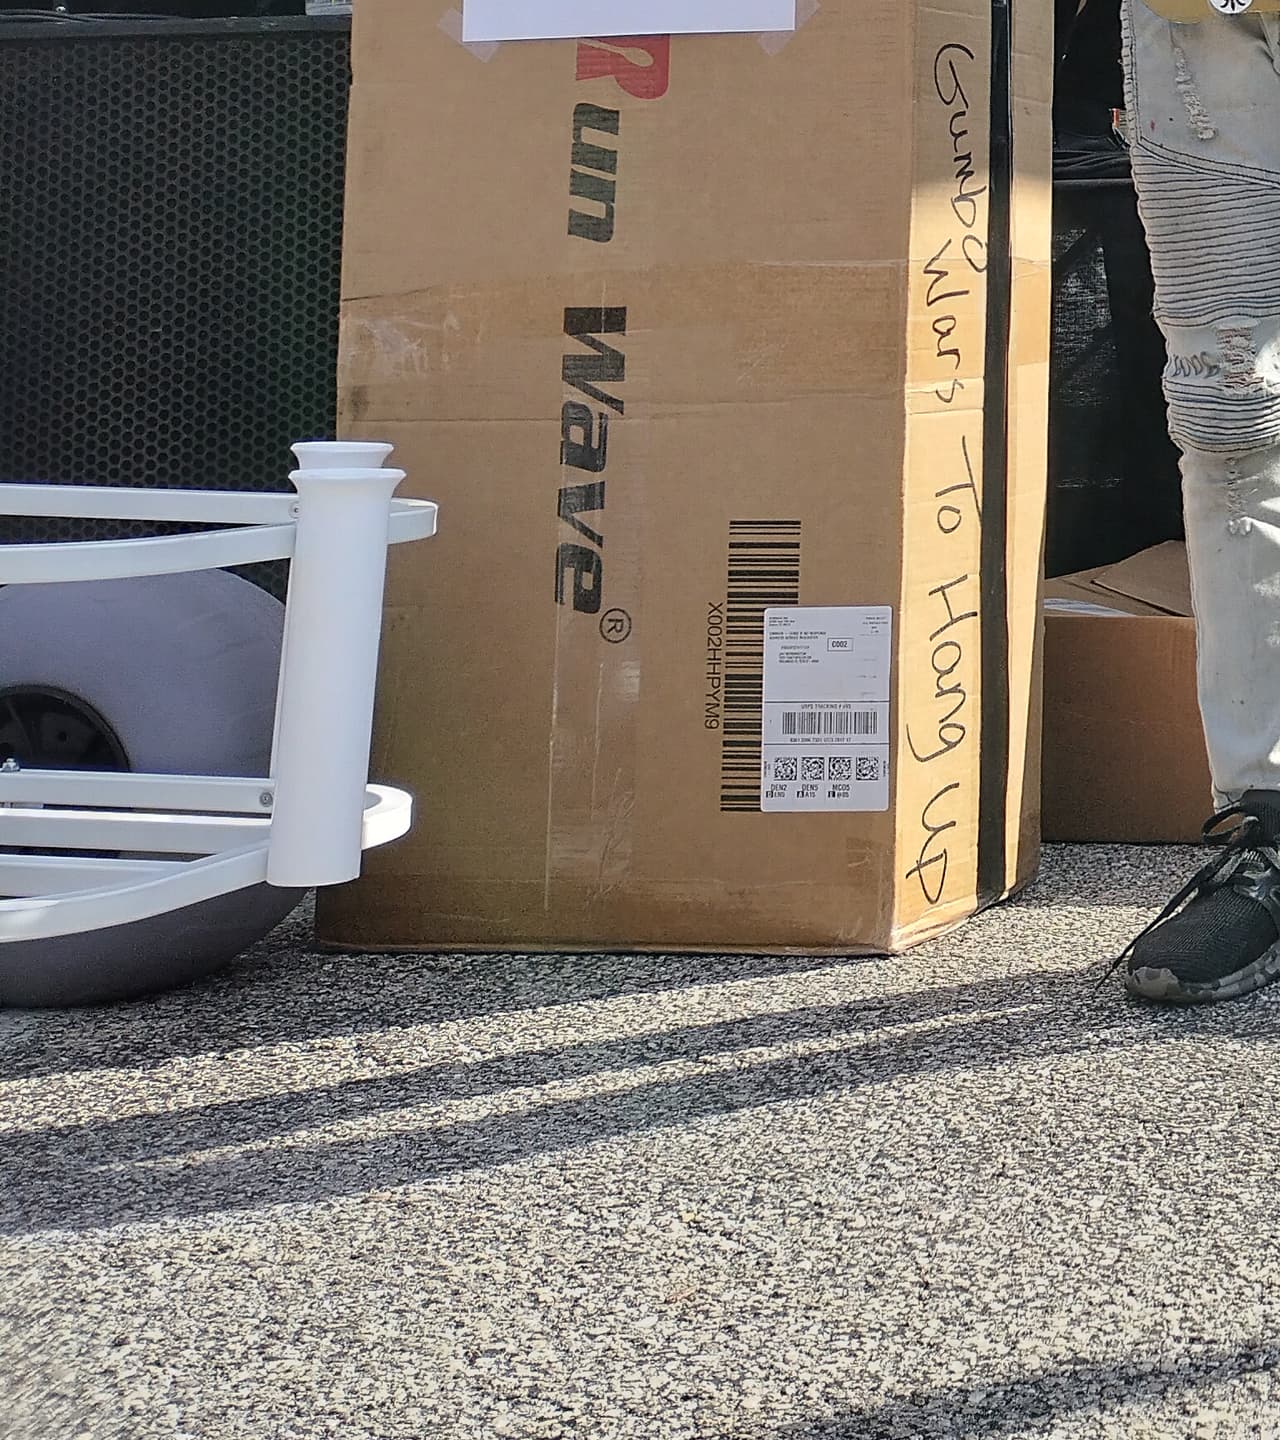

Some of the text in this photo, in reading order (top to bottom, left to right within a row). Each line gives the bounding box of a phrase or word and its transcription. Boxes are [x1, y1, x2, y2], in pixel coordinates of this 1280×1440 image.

[933, 42, 989, 273] Gumbo
[922, 238, 971, 404] Wars
[554, 306, 628, 614] Wave
[704, 601, 723, 730] X002HHPYM9
[906, 573, 979, 764] Hang
